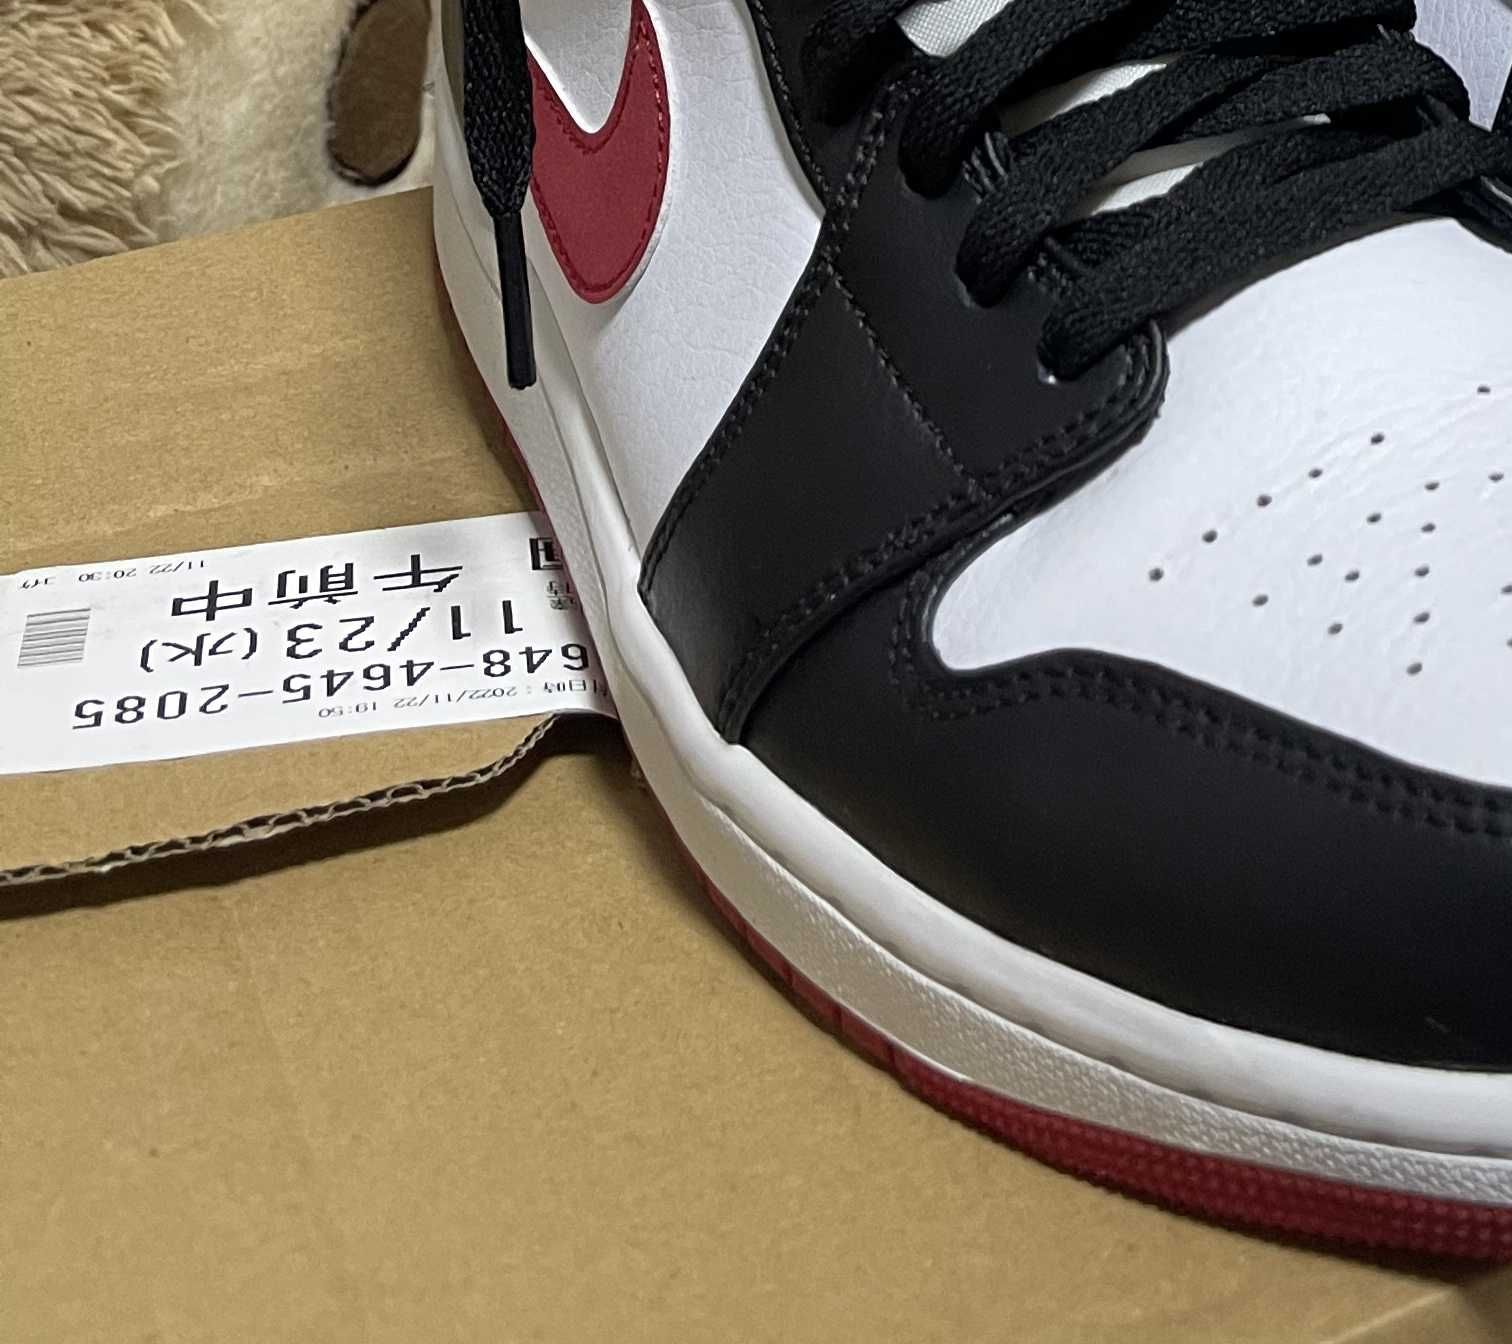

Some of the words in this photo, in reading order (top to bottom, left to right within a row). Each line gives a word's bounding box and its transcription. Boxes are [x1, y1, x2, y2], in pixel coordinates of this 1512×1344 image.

[149, 560, 205, 575] 11/22
[171, 554, 463, 621] 午前中
[72, 643, 589, 729] 648-4645-2085
[393, 686, 516, 709] 2022/11/22
